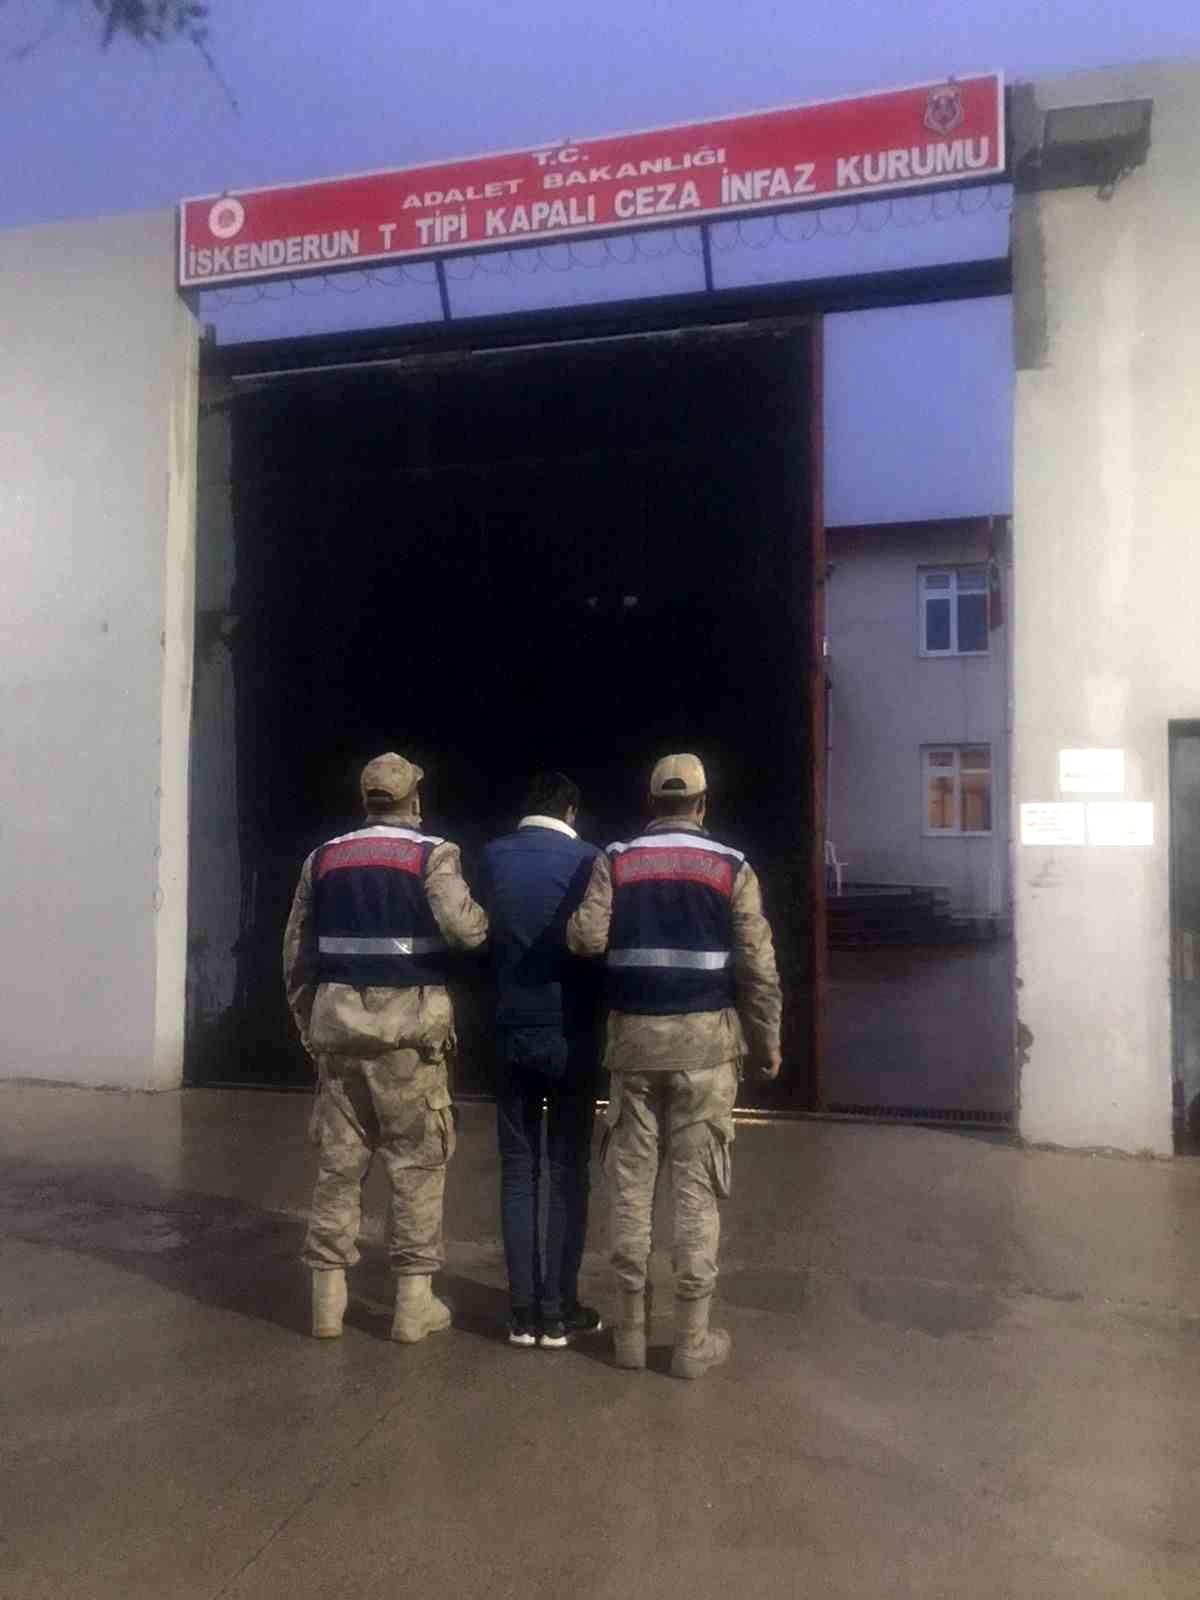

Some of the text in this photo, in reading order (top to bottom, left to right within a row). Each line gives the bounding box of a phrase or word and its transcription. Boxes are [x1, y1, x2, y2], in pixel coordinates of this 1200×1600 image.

[402, 147, 726, 210] ADALET BAKANLIĞI
[531, 147, 589, 166] T.C.
[189, 136, 990, 276] İSKENDERUN T TİPİ KAPALI CEZA İNFAZ KURUMU
